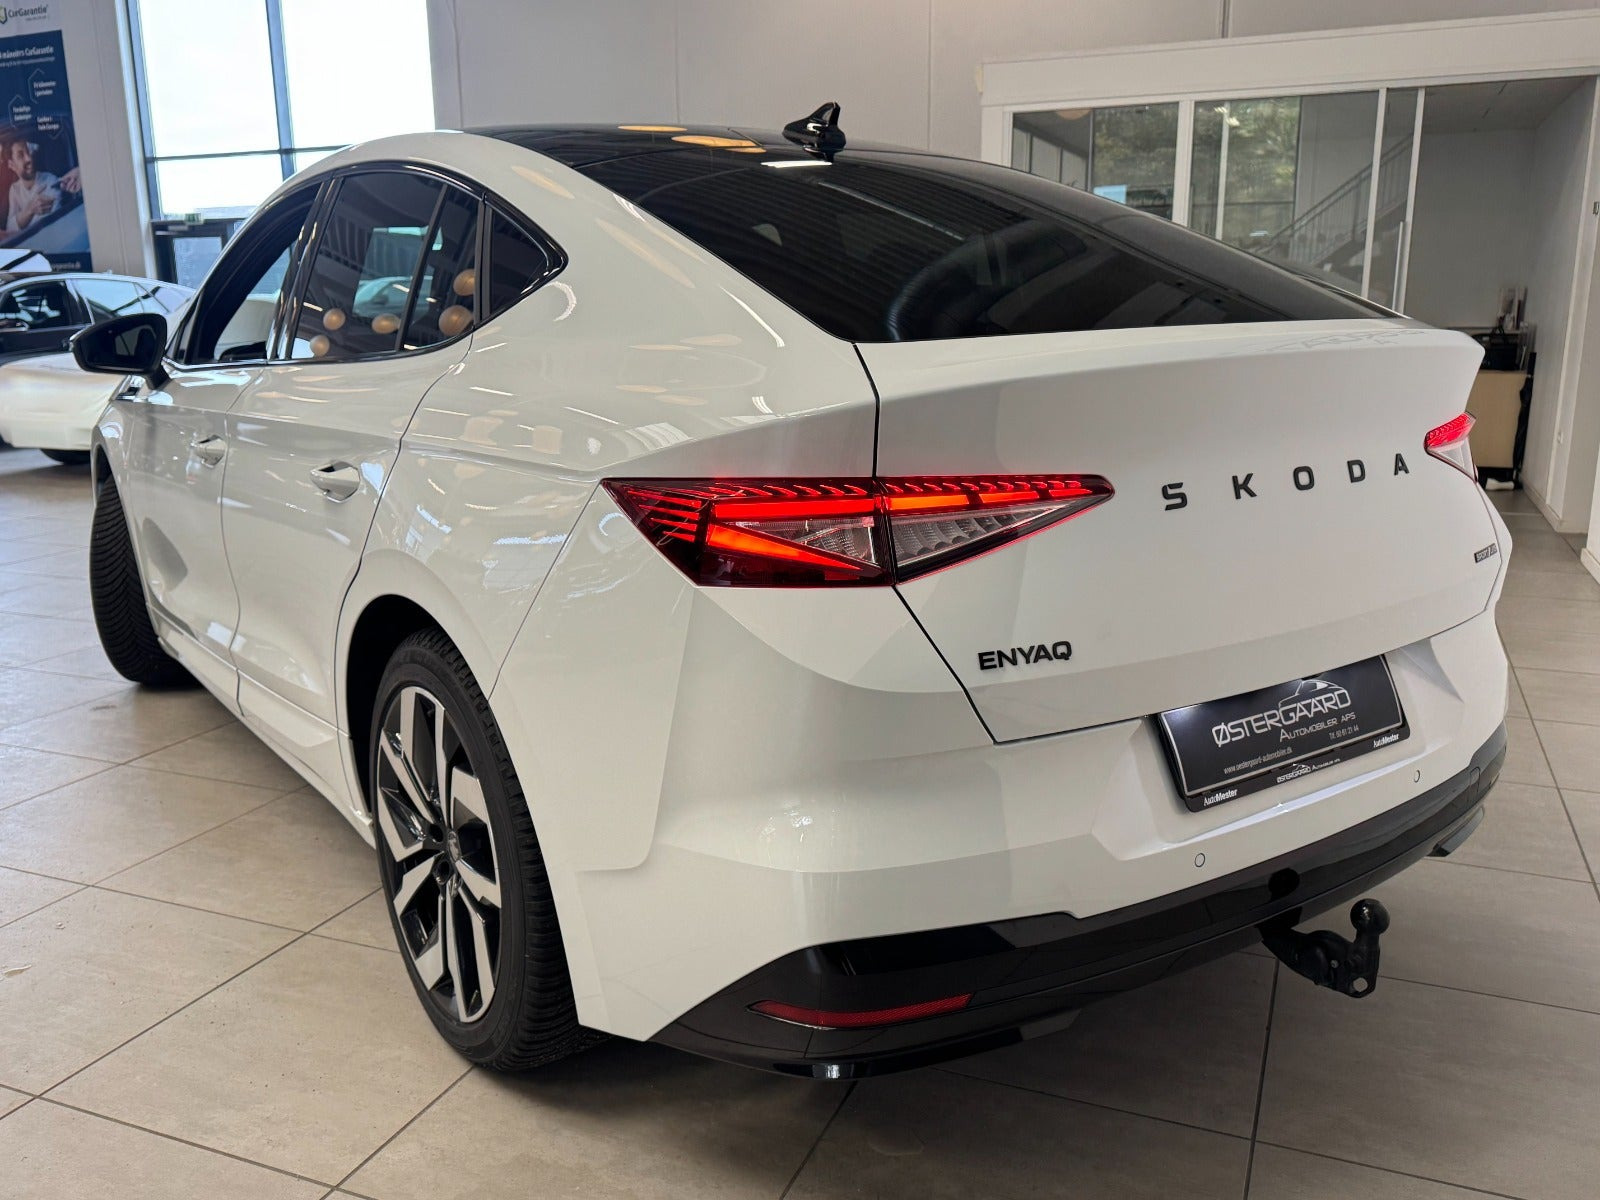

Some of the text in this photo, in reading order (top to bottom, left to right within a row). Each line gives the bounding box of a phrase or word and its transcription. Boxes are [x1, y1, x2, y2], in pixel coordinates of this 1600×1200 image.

[978, 641, 1072, 670] ENYAQ
[1212, 689, 1352, 748] ØSTERGAARD
[1373, 732, 1399, 749] AutoMester
[1203, 788, 1238, 807] AutoMester
